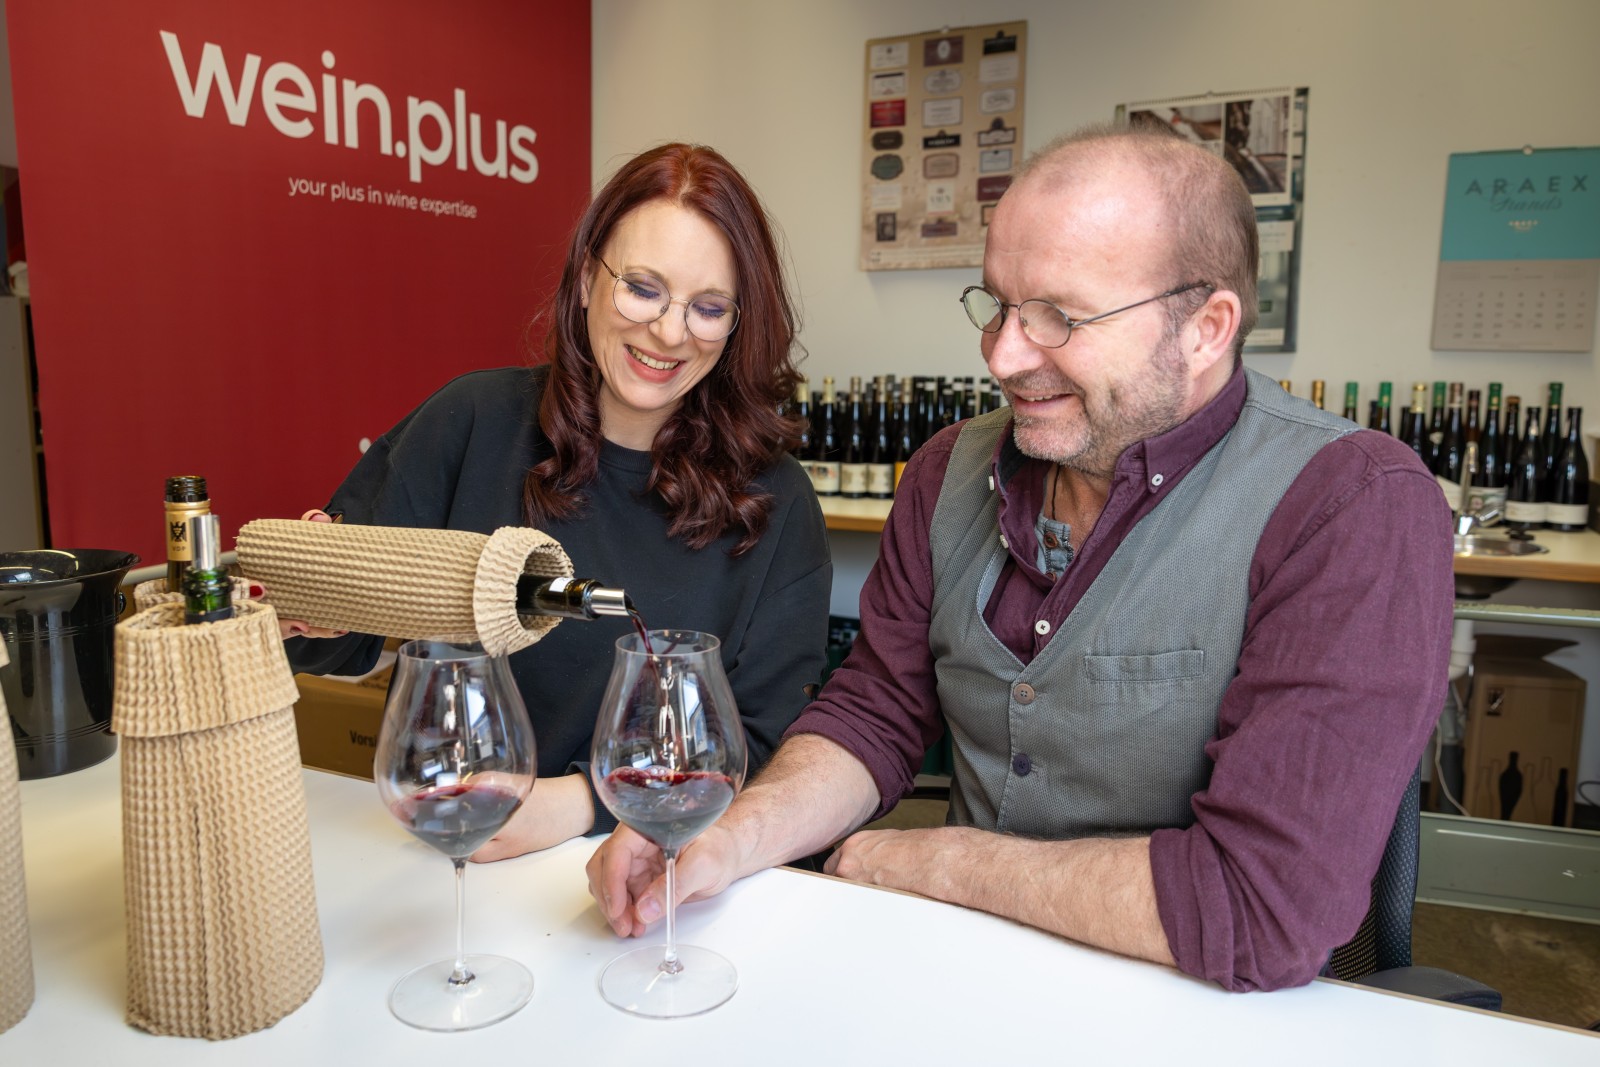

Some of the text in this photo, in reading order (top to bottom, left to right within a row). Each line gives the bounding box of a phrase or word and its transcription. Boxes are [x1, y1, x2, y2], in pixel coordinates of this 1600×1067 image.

[159, 29, 539, 184] wein.plus
[288, 177, 478, 219] your plus in wine expertise
[1465, 175, 1588, 195] ARAEX
[349, 730, 377, 748] Vorsi
